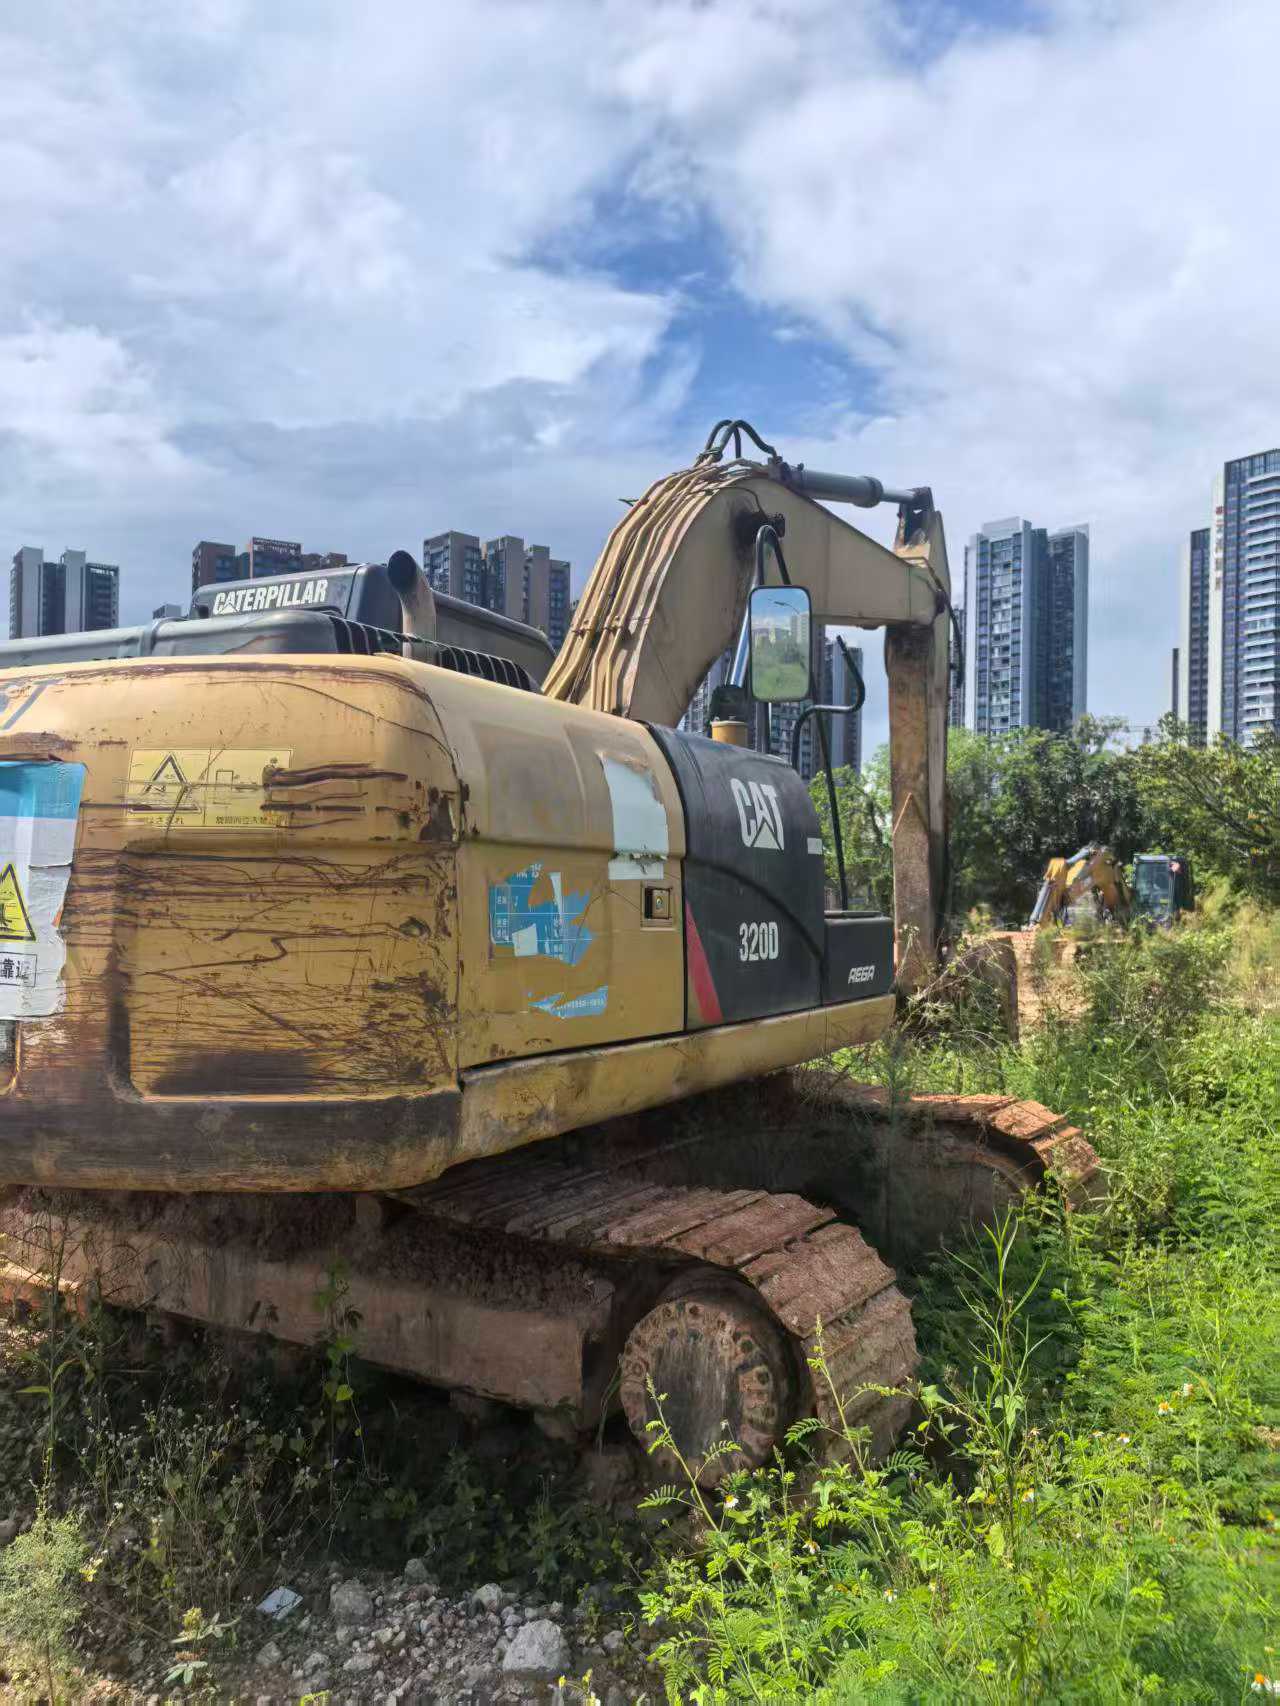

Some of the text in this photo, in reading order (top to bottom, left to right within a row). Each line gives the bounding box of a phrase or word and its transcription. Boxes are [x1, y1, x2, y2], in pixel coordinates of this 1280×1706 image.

[213, 579, 328, 615] CATERPILLAR
[730, 777, 785, 850] CAT
[739, 921, 779, 962] 320D
